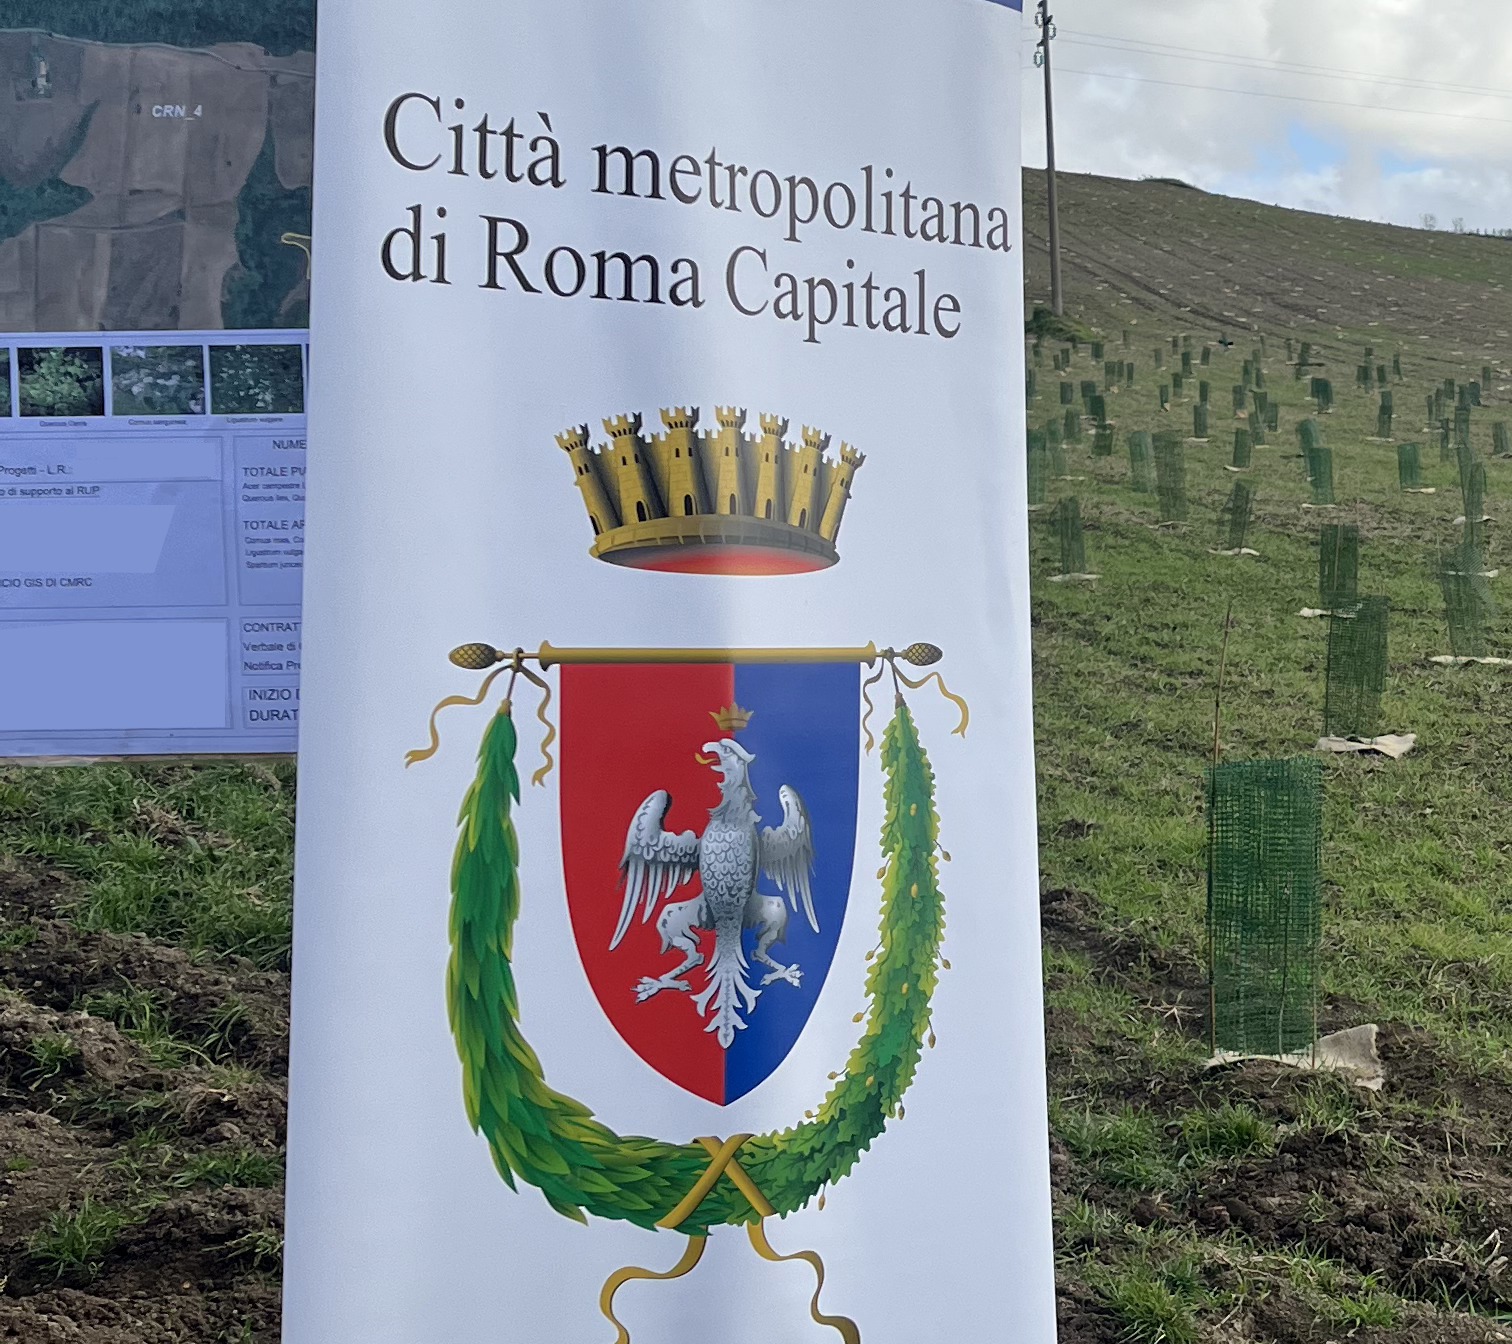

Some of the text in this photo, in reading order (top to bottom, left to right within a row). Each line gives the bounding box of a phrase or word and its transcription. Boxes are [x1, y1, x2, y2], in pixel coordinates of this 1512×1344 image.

[152, 105, 202, 121] CRN_4
[383, 92, 1013, 253] Città metropolitana
[381, 203, 962, 344] di Roma Capitale
[242, 466, 288, 477] TOTALE
[8, 487, 17, 496] di
[19, 487, 63, 498] supporto
[65, 486, 74, 495] al
[77, 485, 100, 495] RUP
[243, 520, 289, 530] TOTALE
[24, 578, 43, 587] GIS
[45, 578, 57, 587] DI
[242, 641, 283, 652] Verbale
[286, 641, 296, 652] di
[243, 660, 283, 671] Notifica
[248, 688, 292, 701] INIZIO
